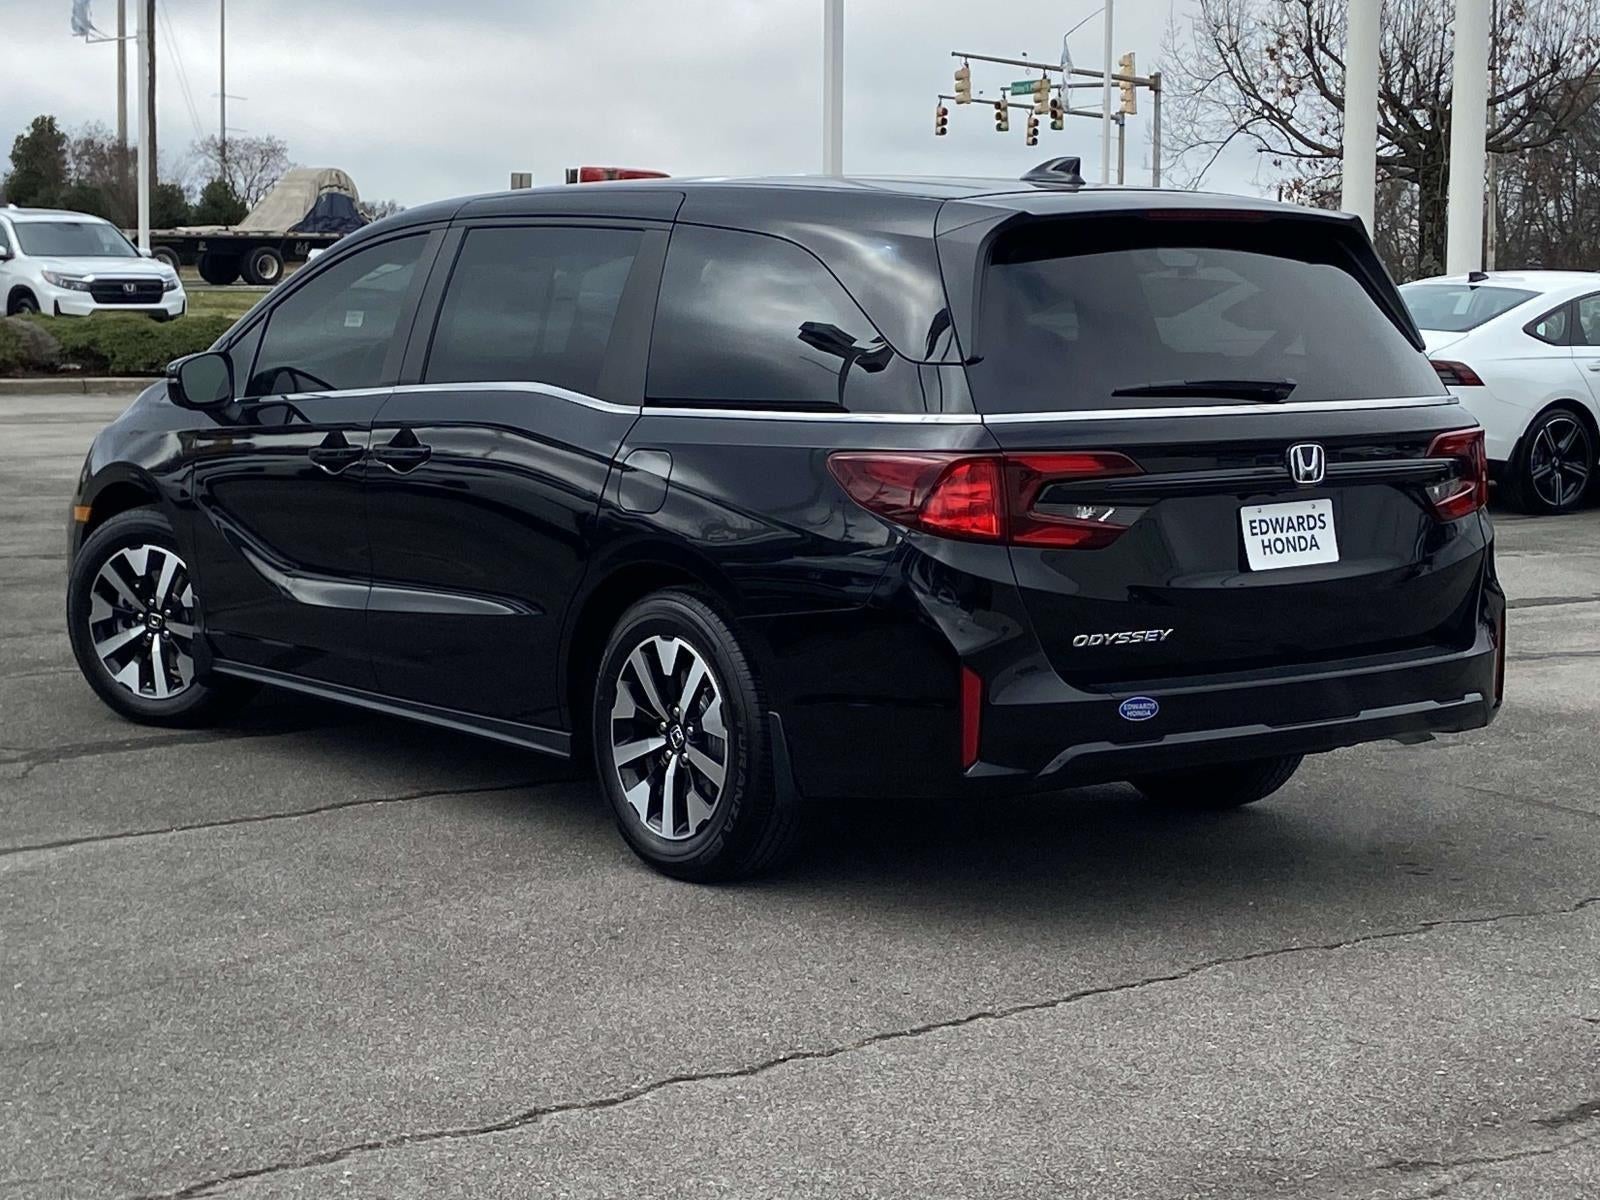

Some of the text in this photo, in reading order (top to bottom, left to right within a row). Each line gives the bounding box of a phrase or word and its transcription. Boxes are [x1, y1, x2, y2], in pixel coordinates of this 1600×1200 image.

[1248, 513, 1327, 537] EDWARDS
[1261, 534, 1321, 556] HONDA
[1072, 628, 1175, 647] ODYSSEY
[1123, 702, 1156, 711] EDWARDS
[1126, 709, 1152, 717] HONDA
[723, 720, 747, 833] TURANZA
